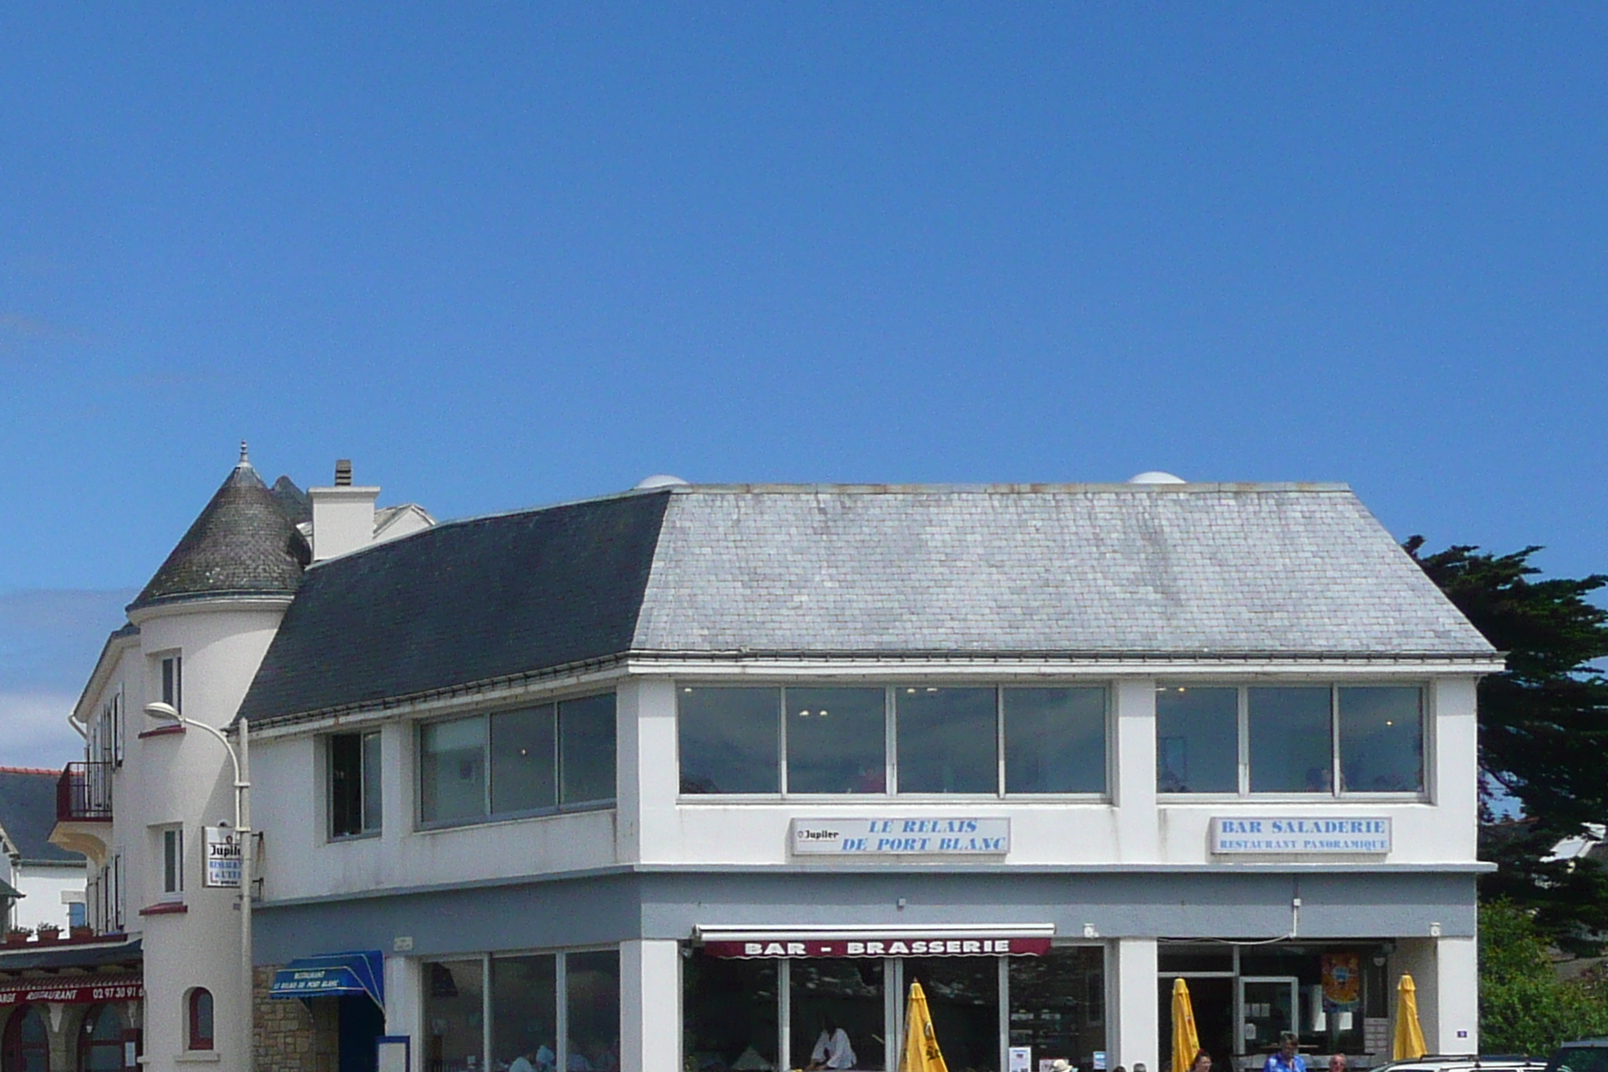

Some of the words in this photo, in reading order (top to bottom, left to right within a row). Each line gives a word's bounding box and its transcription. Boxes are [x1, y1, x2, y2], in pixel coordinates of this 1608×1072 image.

[868, 820, 892, 833] LE
[902, 820, 978, 833] RELAIS
[1222, 821, 1262, 833] BAR
[1272, 820, 1385, 833] SALADERIE
[804, 829, 839, 840] Jupiler
[842, 837, 868, 850] DE
[877, 837, 930, 850] PORT
[938, 837, 1006, 850] BLANC
[1220, 839, 1297, 849] RESTAURANT
[1303, 839, 1388, 851] PANORAMIQUE
[745, 942, 807, 955] BAR
[847, 940, 1011, 955] BRASSERIE
[93, 988, 104, 999] 02
[104, 987, 114, 998] 97
[115, 987, 125, 998] 30
[126, 987, 136, 997] 91
